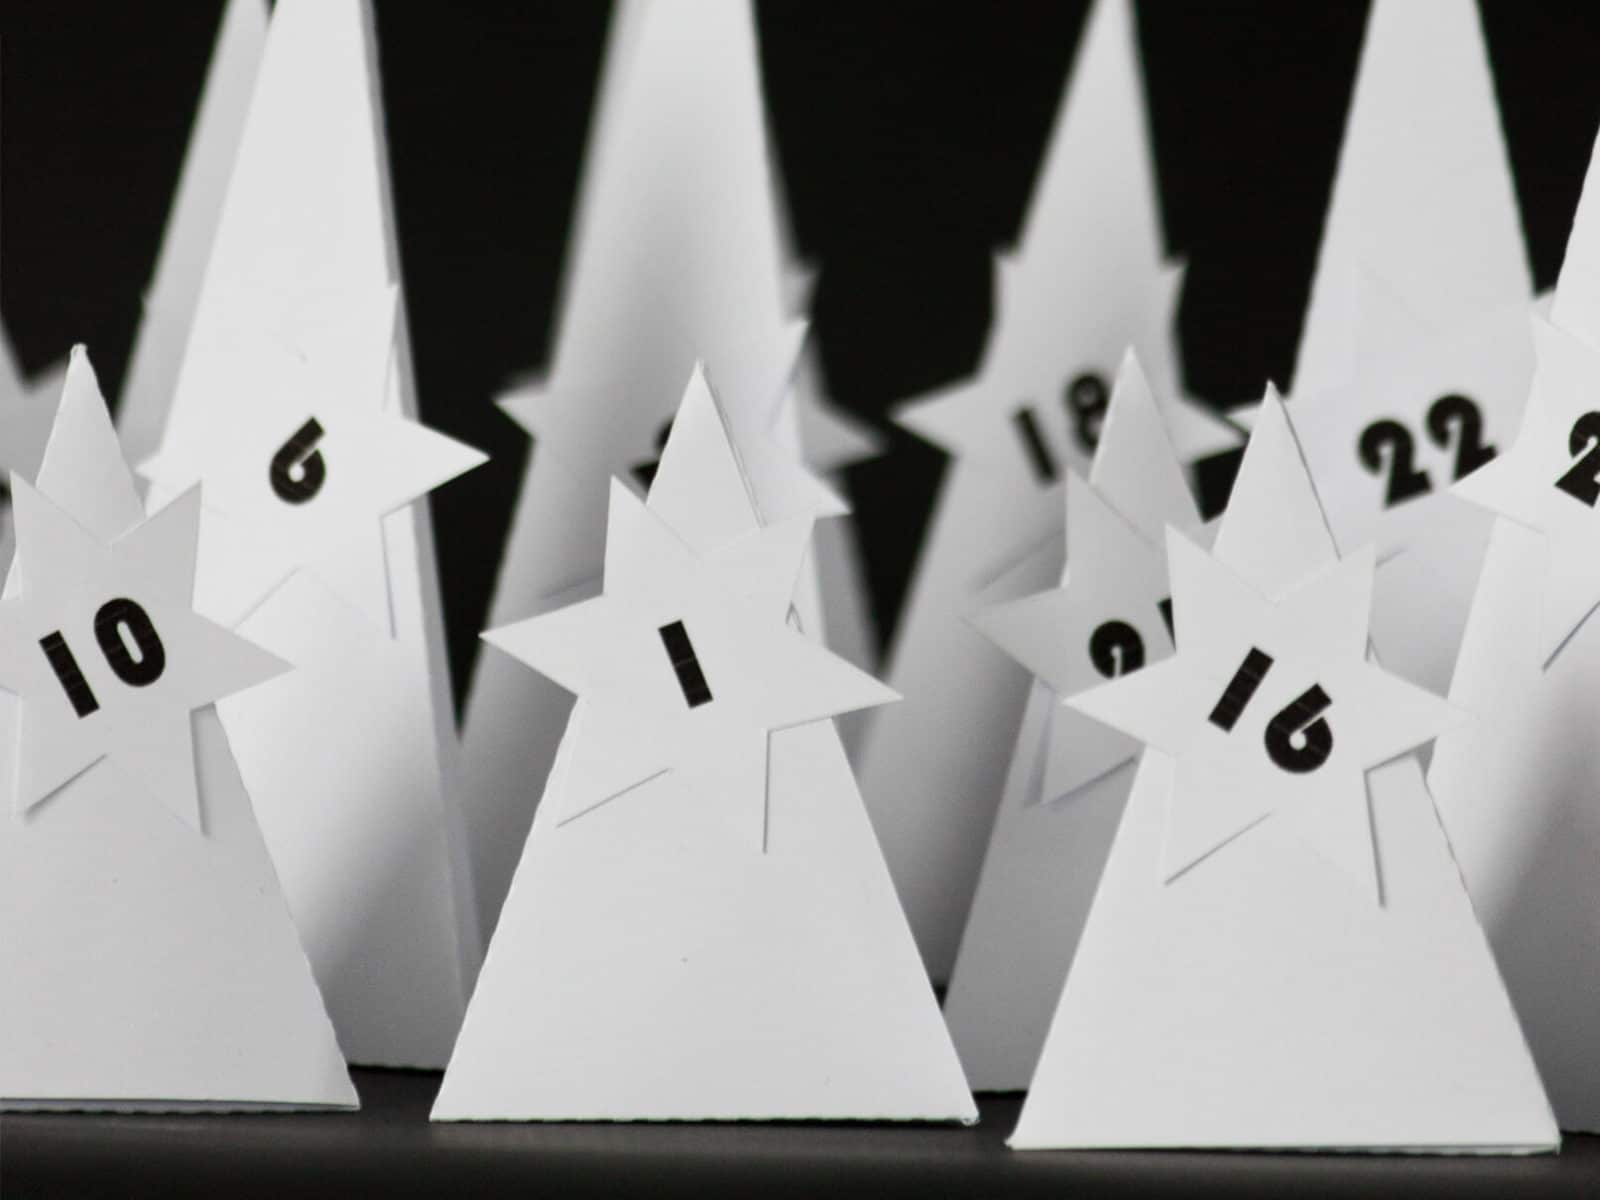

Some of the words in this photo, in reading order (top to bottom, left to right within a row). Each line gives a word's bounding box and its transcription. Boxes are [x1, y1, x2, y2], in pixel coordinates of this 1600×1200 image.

[269, 417, 326, 504] 6
[1357, 394, 1497, 507] 22
[39, 597, 166, 718] 10
[658, 620, 713, 708] 1
[1208, 647, 1333, 774] 16
